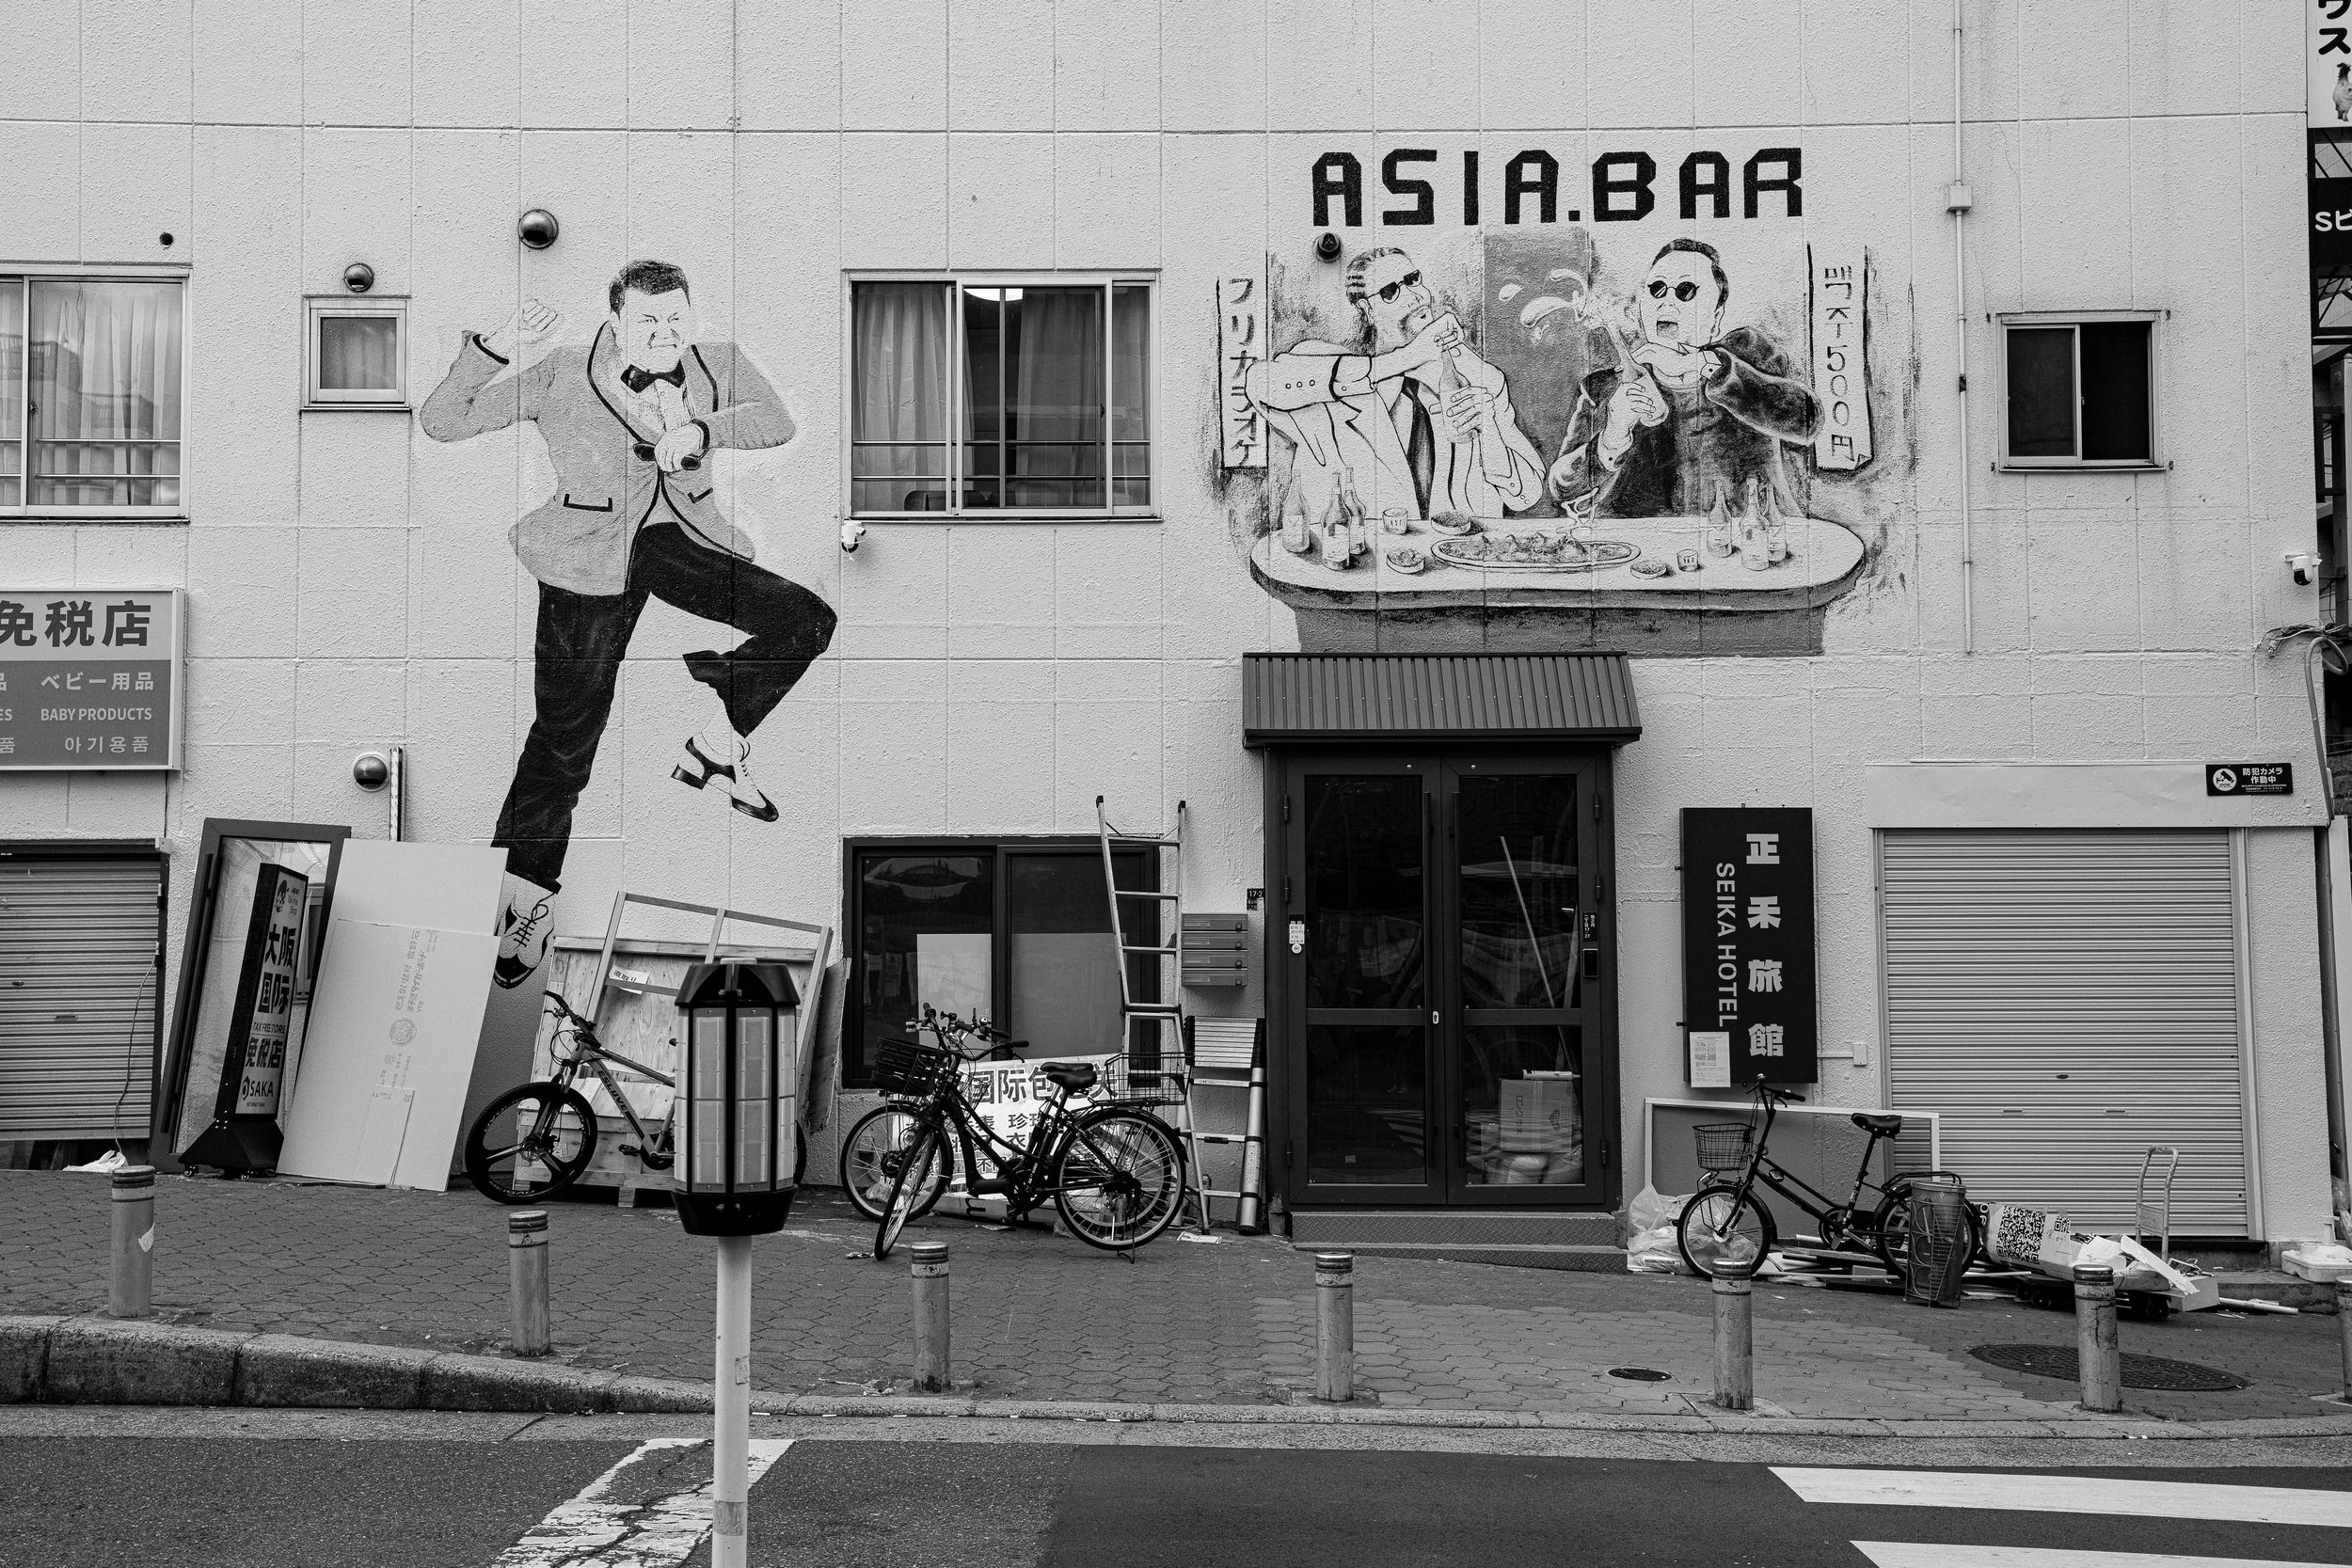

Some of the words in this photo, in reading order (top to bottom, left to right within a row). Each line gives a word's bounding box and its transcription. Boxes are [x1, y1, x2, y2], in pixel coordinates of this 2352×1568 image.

[1311, 147, 1803, 227] ASIA.BAR
[0, 599, 151, 647] 免税店
[40, 672, 154, 691] ベビー用品
[40, 707, 76, 721] BABY
[78, 707, 152, 721] PRODUCTS
[64, 736, 149, 753] 아기용품
[2242, 768, 2283, 776] 防犯カメラ
[2250, 775, 2277, 784] 作動中
[1716, 862, 1737, 938] SEIKA
[264, 924, 296, 968] 大阪
[1717, 944, 1738, 1027] HOTEL
[252, 1022, 262, 1032] TAX
